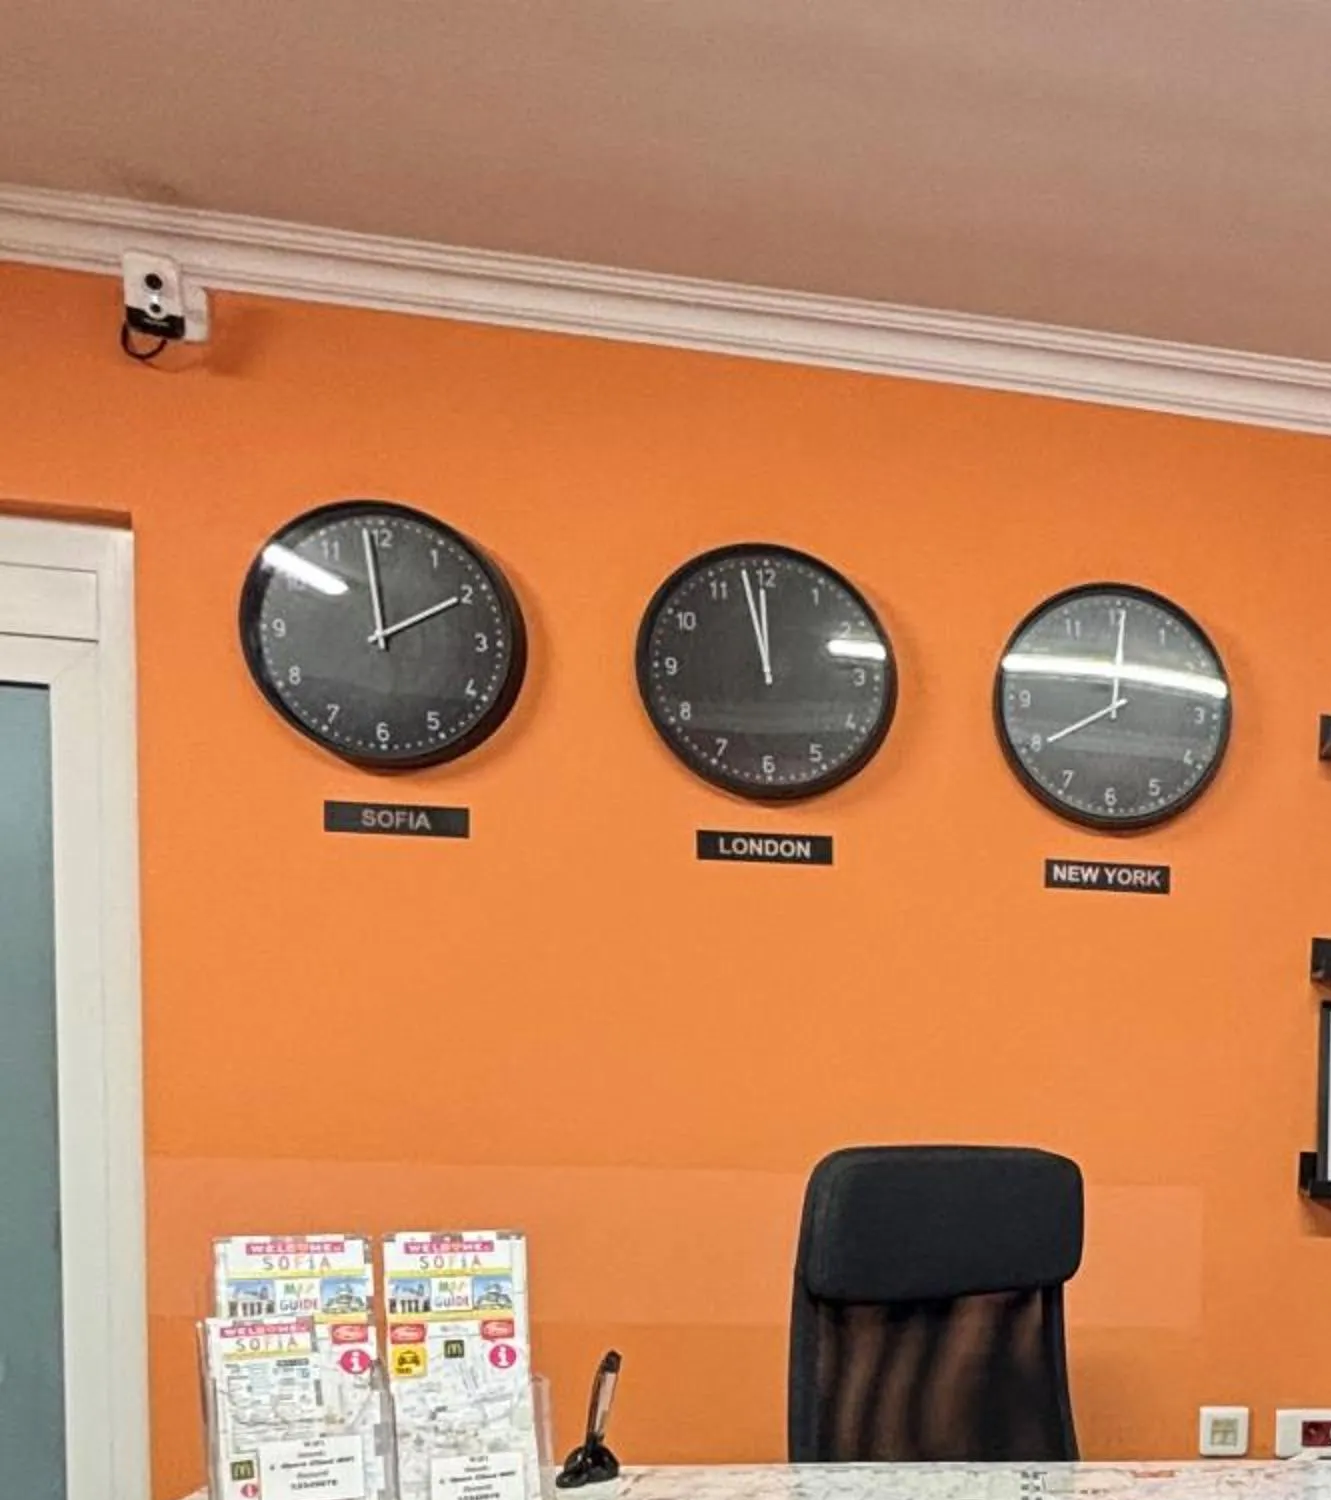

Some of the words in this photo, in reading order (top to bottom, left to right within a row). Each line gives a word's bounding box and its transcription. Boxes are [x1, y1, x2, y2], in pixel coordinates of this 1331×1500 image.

[372, 529, 393, 548] 12
[321, 540, 341, 560] 11
[430, 550, 440, 568] 1
[755, 568, 776, 588] 12
[460, 584, 474, 604] 2
[709, 580, 728, 600] 11
[811, 588, 820, 605] 1
[272, 618, 286, 638] 9
[676, 611, 697, 631] 10
[1065, 618, 1082, 637] 11
[474, 633, 489, 652] 3
[288, 666, 302, 685] 8
[664, 657, 677, 676] 9
[853, 667, 866, 686] 3
[464, 679, 478, 697] 4
[1019, 690, 1031, 709] 9
[326, 704, 340, 724] 7
[679, 701, 691, 721] 8
[1194, 707, 1205, 724] 3
[426, 711, 441, 731] 5
[844, 713, 856, 731] 4
[376, 722, 390, 742] 6
[714, 737, 728, 756] 7
[809, 743, 822, 762] 5
[1030, 734, 1042, 752] 8
[762, 755, 776, 774] 6
[1061, 769, 1074, 789] 7
[1149, 778, 1161, 797] 5
[1104, 787, 1117, 806] 6
[361, 808, 431, 830] SOFIA
[719, 837, 811, 858] LONDON
[1053, 864, 1099, 884] NEW
[1103, 867, 1162, 888] YORK
[262, 1255, 331, 1270] SOFIA
[419, 1254, 482, 1269] SOFIA
[235, 1335, 299, 1351] SOFIA
